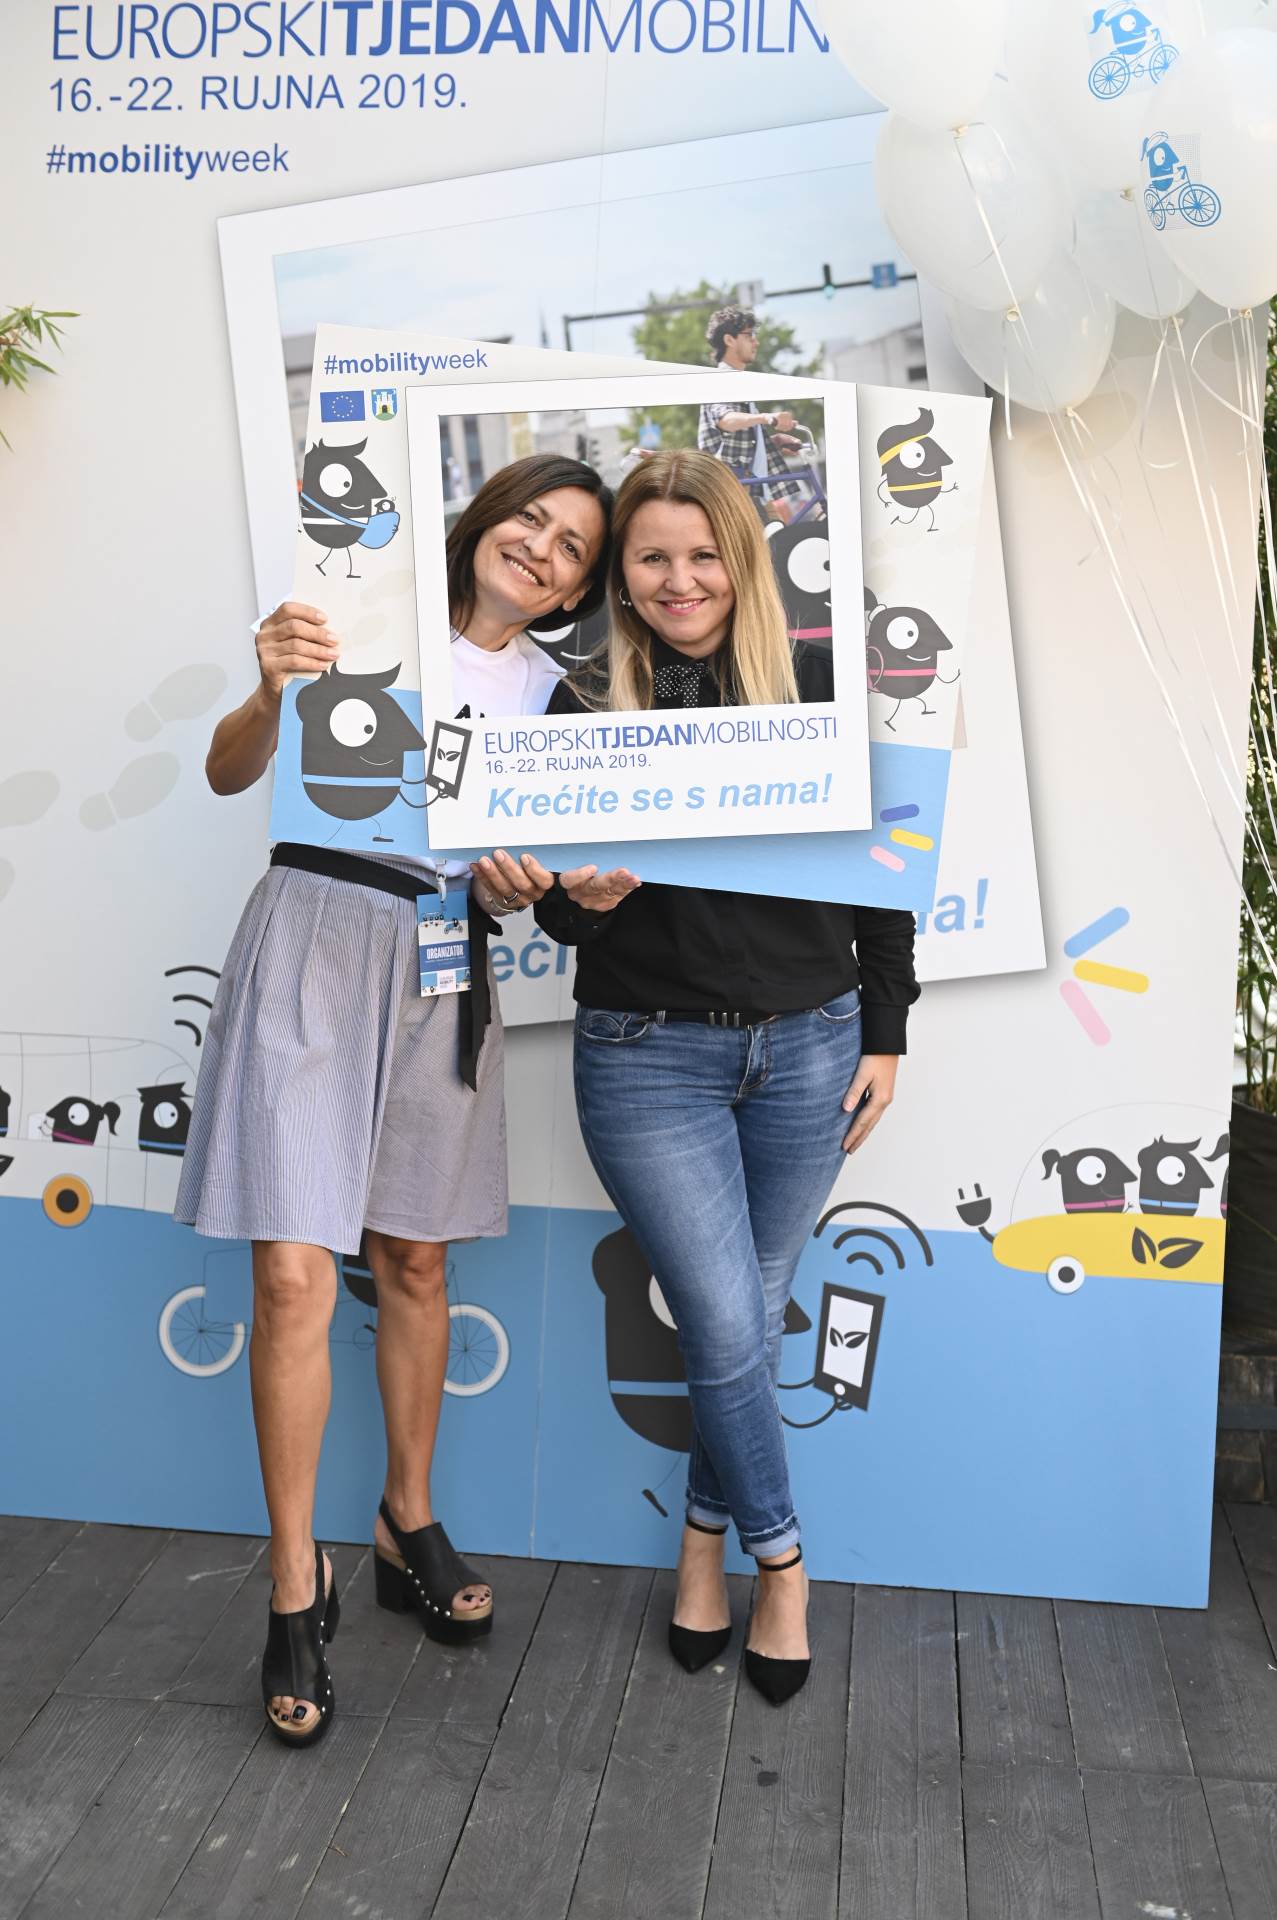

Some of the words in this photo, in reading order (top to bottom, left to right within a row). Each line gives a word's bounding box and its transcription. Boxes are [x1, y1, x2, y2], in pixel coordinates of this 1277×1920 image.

[50, 76, 182, 112] 16.-22.
[200, 74, 345, 111] RUJNA
[358, 73, 466, 109] 2019.
[46, 143, 289, 180] #mobilityweek
[324, 349, 488, 376] #mobilityweek
[485, 717, 837, 755] EUROPSKITJEDANMOBILNOSTI
[486, 757, 541, 774] 16.-22.
[546, 755, 604, 772] RUJNA
[609, 753, 652, 770] 2019.
[488, 784, 619, 819] Krećite
[631, 787, 674, 812] se
[685, 786, 706, 810] s
[719, 772, 833, 808] nama!
[426, 944, 464, 961] ORGANIZATOR
